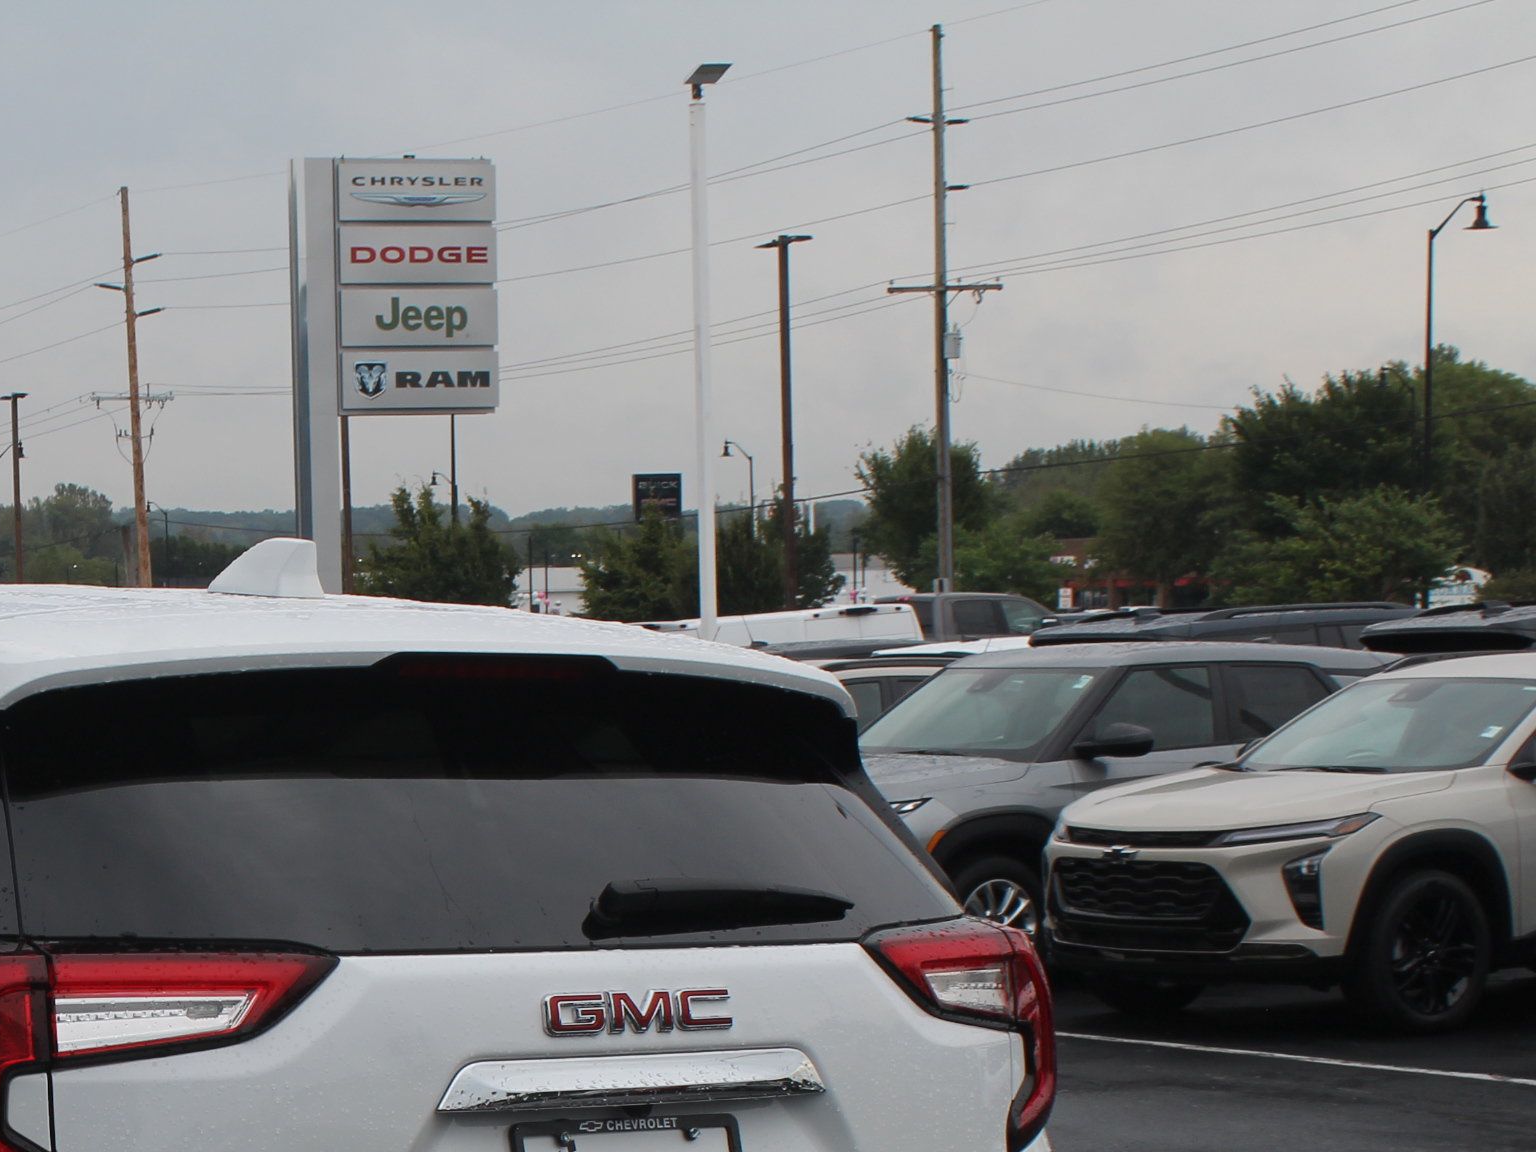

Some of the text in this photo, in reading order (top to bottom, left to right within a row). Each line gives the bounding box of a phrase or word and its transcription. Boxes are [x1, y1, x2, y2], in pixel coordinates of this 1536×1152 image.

[351, 176, 484, 187] CHRYSLER
[350, 246, 489, 264] DODGE
[375, 296, 468, 338] Jeep
[395, 371, 491, 388] RAM
[542, 987, 734, 1037] GMC
[606, 1117, 678, 1131] CHEVROLET
